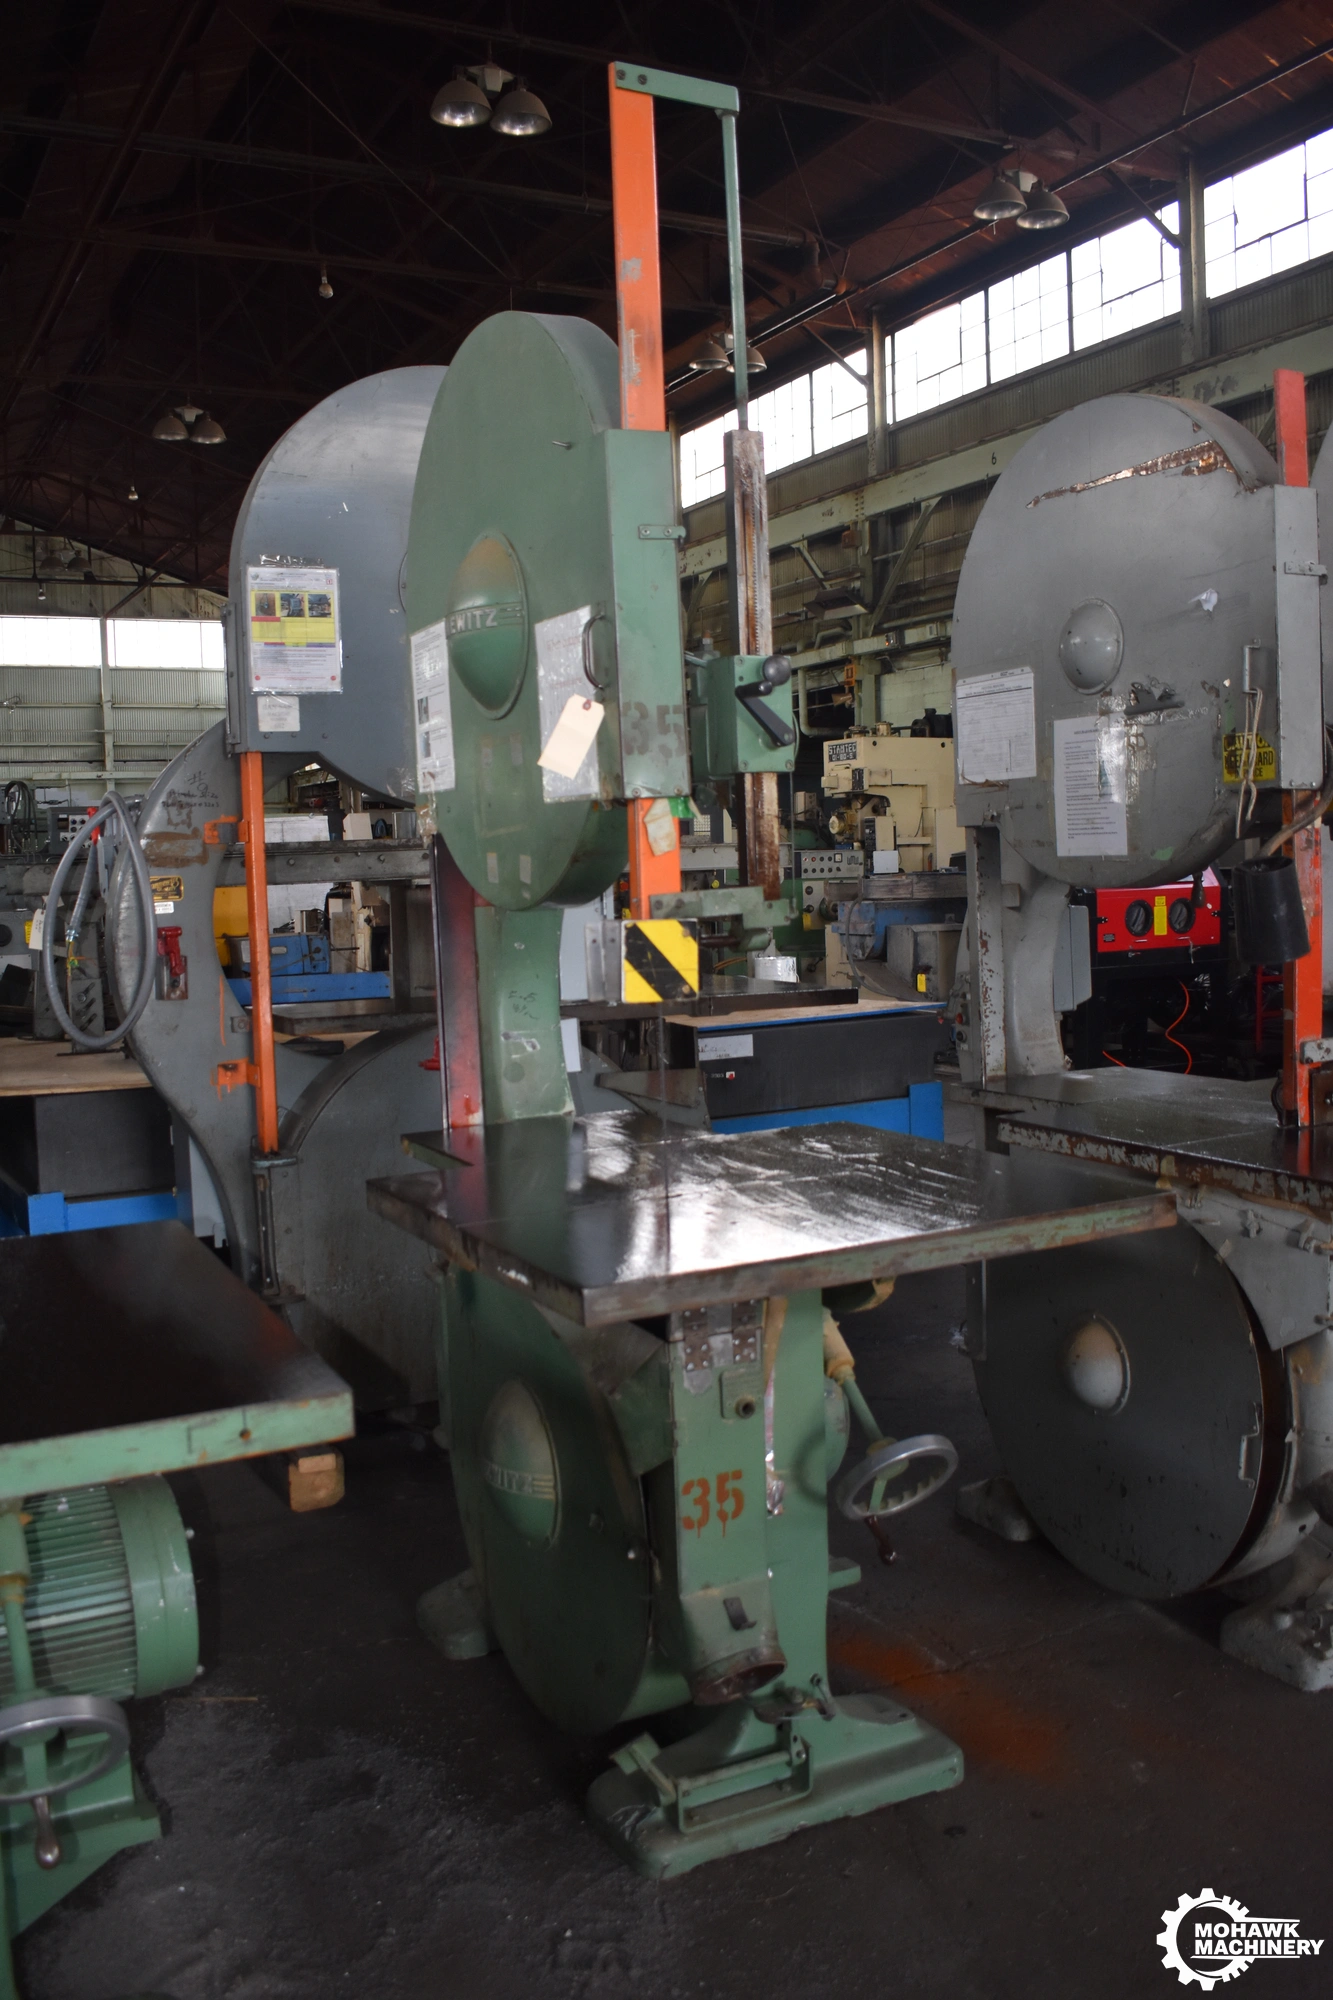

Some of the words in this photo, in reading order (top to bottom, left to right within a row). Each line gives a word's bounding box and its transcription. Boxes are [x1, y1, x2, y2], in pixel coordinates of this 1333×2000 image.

[446, 608, 498, 637] EWITZ
[622, 702, 686, 758] 35
[829, 743, 856, 755] STAMTEC
[682, 1469, 744, 1530] 35
